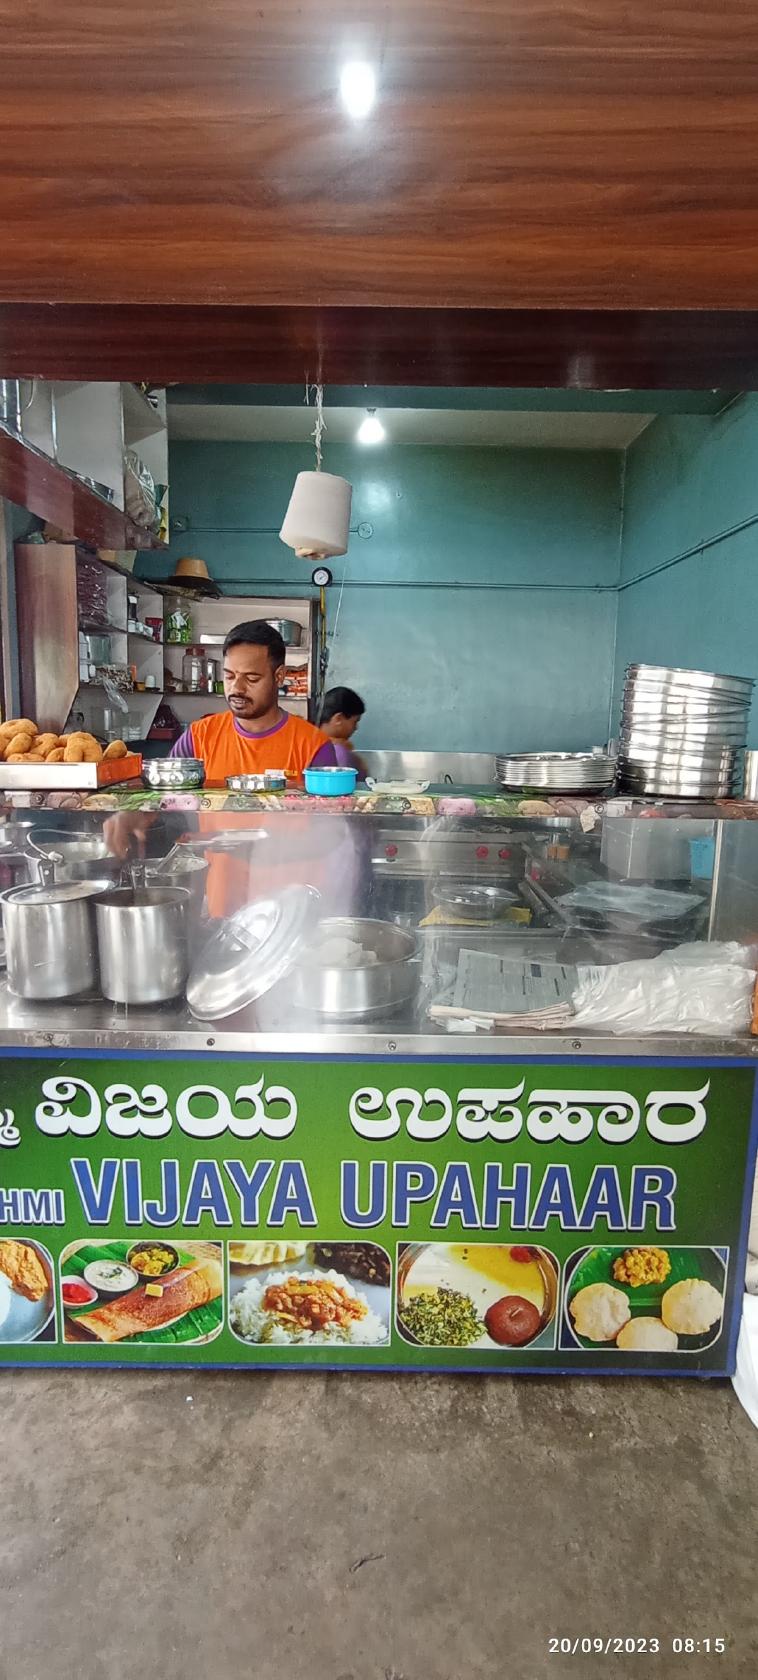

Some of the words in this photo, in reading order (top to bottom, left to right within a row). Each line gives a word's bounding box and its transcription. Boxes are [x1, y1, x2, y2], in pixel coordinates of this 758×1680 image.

[35, 1073, 298, 1139] ವಿಜಯ
[349, 1076, 711, 1143] ಉಪಹಾರ
[70, 1158, 318, 1227] VIJAYA
[340, 1160, 677, 1231] UPAHAAR
